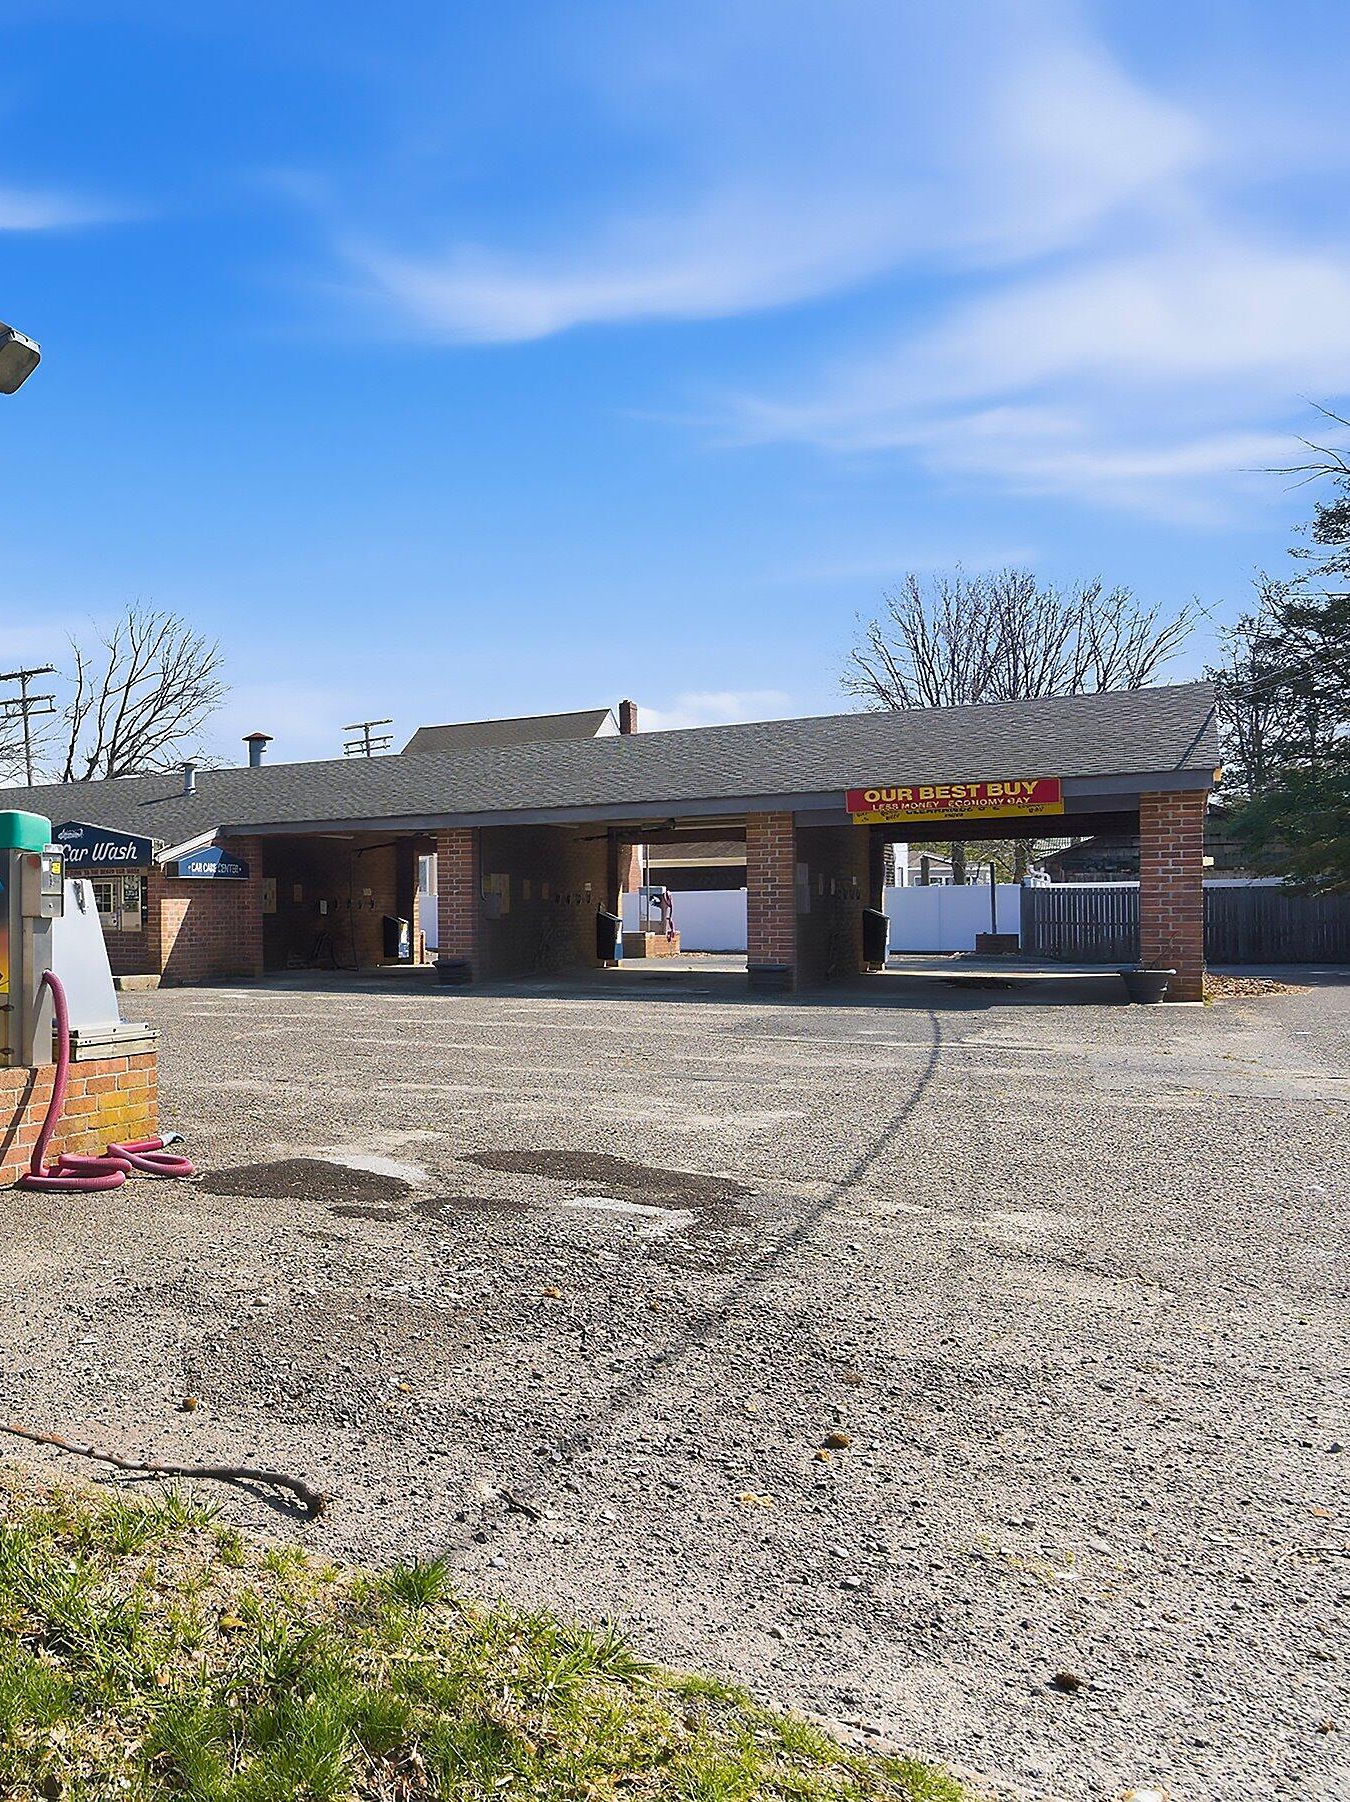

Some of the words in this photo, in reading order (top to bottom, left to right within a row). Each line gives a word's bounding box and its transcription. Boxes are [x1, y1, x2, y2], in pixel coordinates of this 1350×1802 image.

[863, 788, 913, 803] OUR
[919, 784, 981, 800] BEST
[987, 780, 1039, 797] BUY
[872, 802, 899, 812] LESS
[901, 800, 940, 810] MONEY
[948, 797, 1004, 809] ECONOMY
[62, 843, 89, 862] Car
[91, 841, 138, 862] Wash
